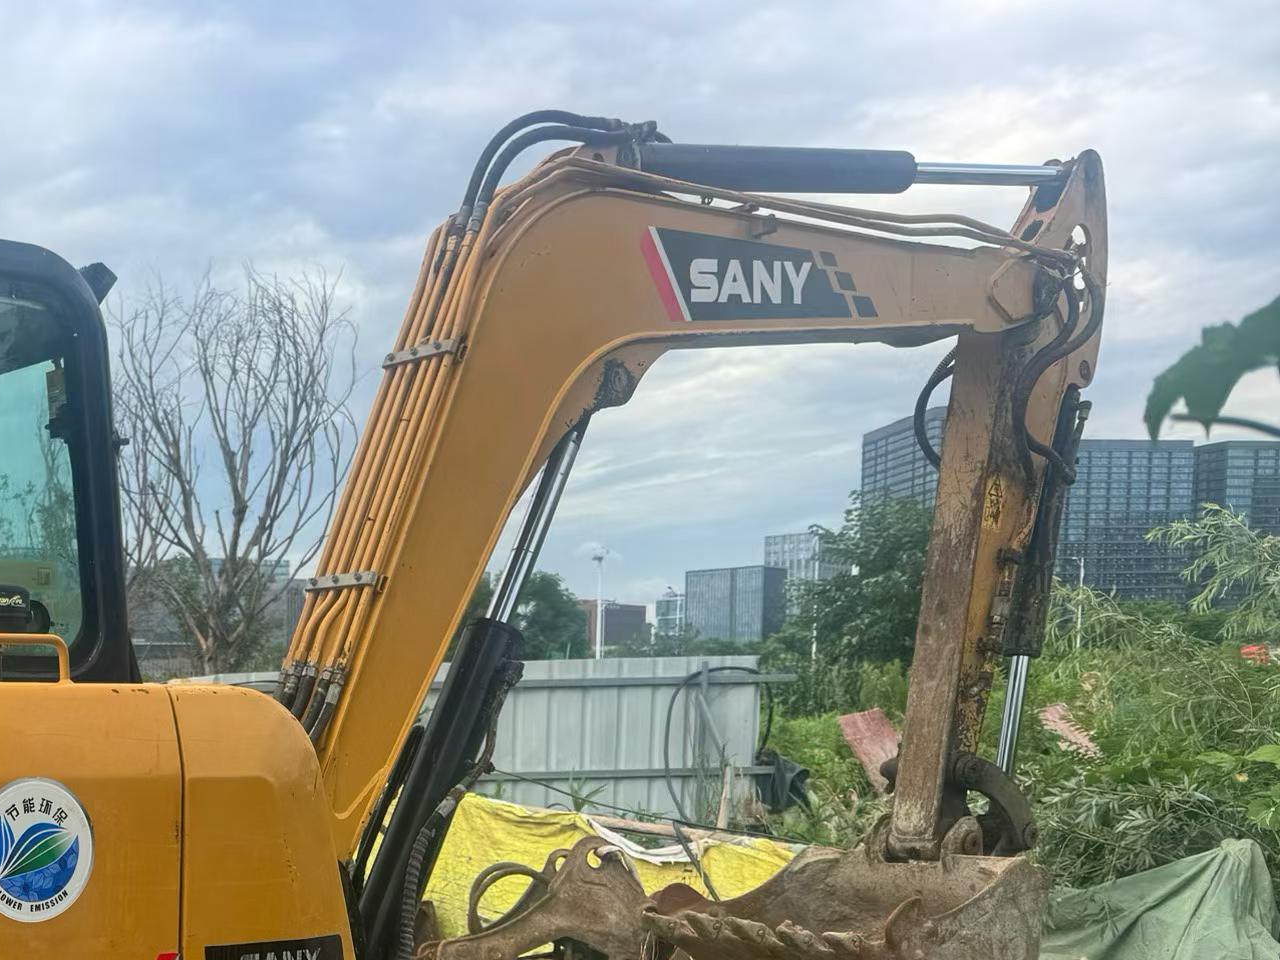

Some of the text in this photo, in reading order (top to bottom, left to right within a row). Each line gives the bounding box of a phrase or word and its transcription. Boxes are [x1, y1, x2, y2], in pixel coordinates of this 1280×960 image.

[690, 258, 812, 304] SANY
[5, 797, 68, 825] 节能环保
[30, 889, 69, 912] EMISSION
